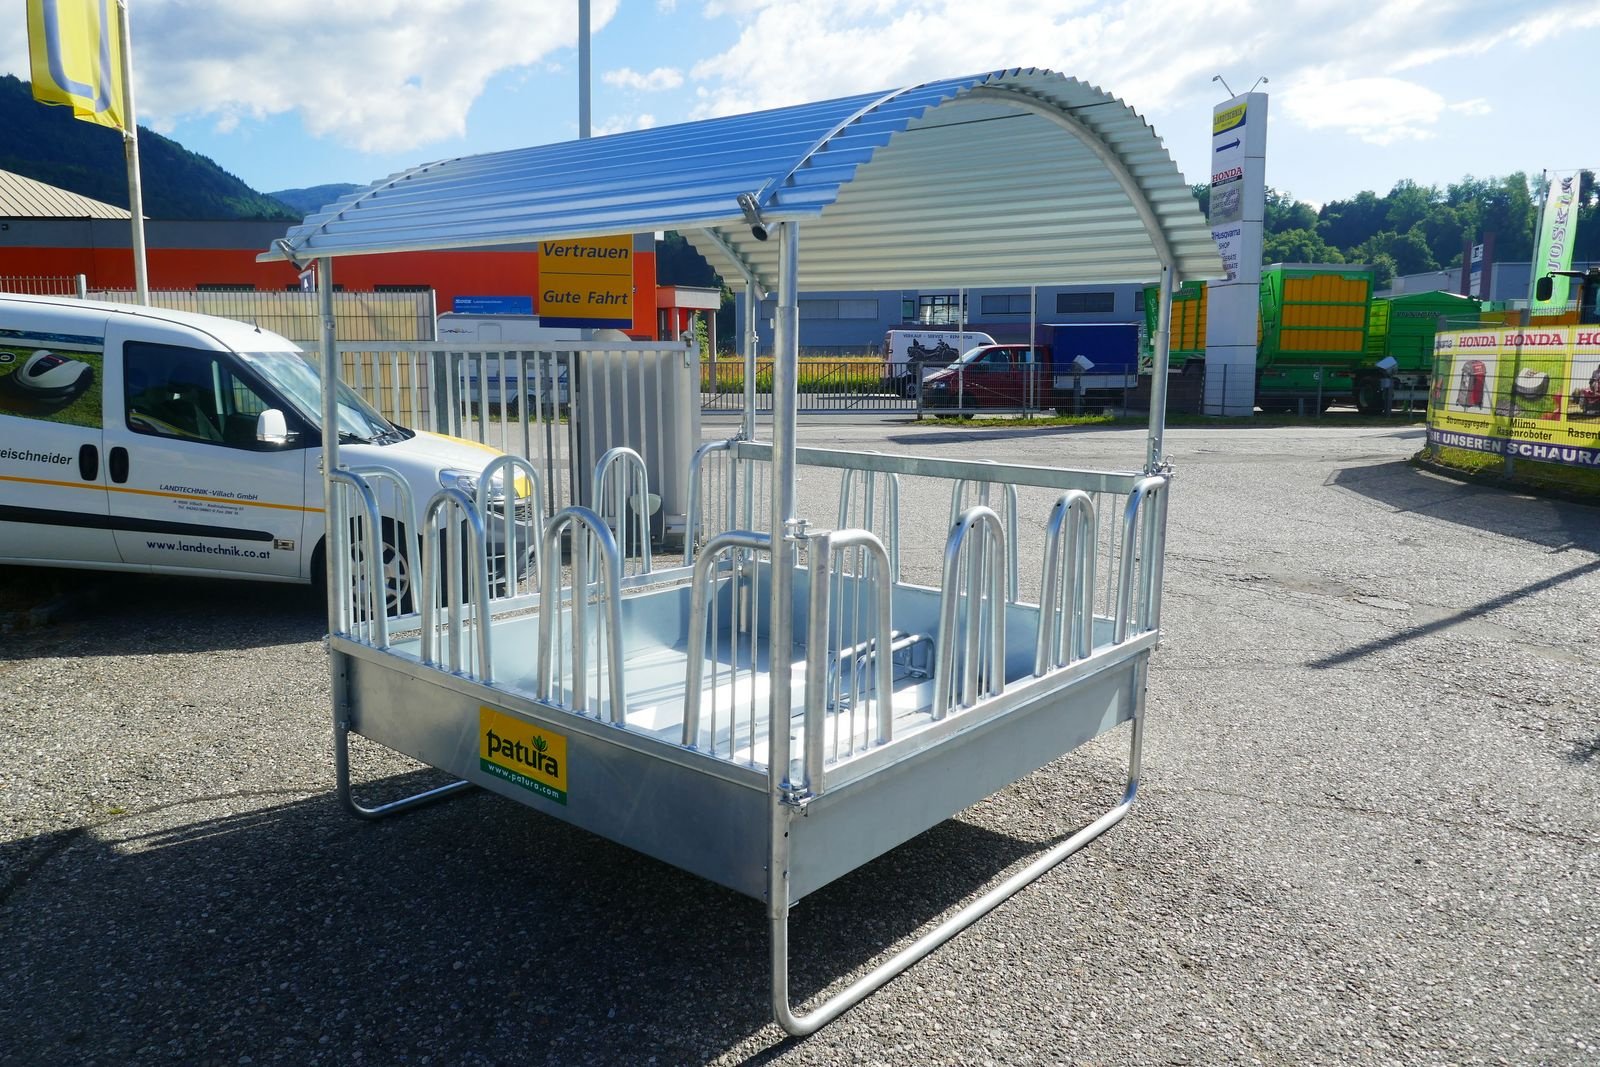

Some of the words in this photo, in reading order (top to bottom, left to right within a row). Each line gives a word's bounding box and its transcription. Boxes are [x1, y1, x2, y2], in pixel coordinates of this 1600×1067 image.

[1212, 167, 1243, 182] HONDA
[543, 243, 629, 259] Vertrauen
[543, 290, 581, 304] Gute
[587, 291, 629, 305] Fahrt
[1458, 336, 1497, 348] HONDA
[1503, 333, 1564, 347] HONDA
[1511, 418, 1537, 430] Miimo
[1496, 427, 1553, 441] Rasenroboter
[1442, 434, 1501, 453] UNSEREN
[0, 448, 73, 465] eischneider
[236, 492, 258, 501] GmbH
[146, 540, 271, 560] www.landtechnik.co.at
[486, 728, 559, 778] patura
[488, 764, 559, 799] www.patura.com
